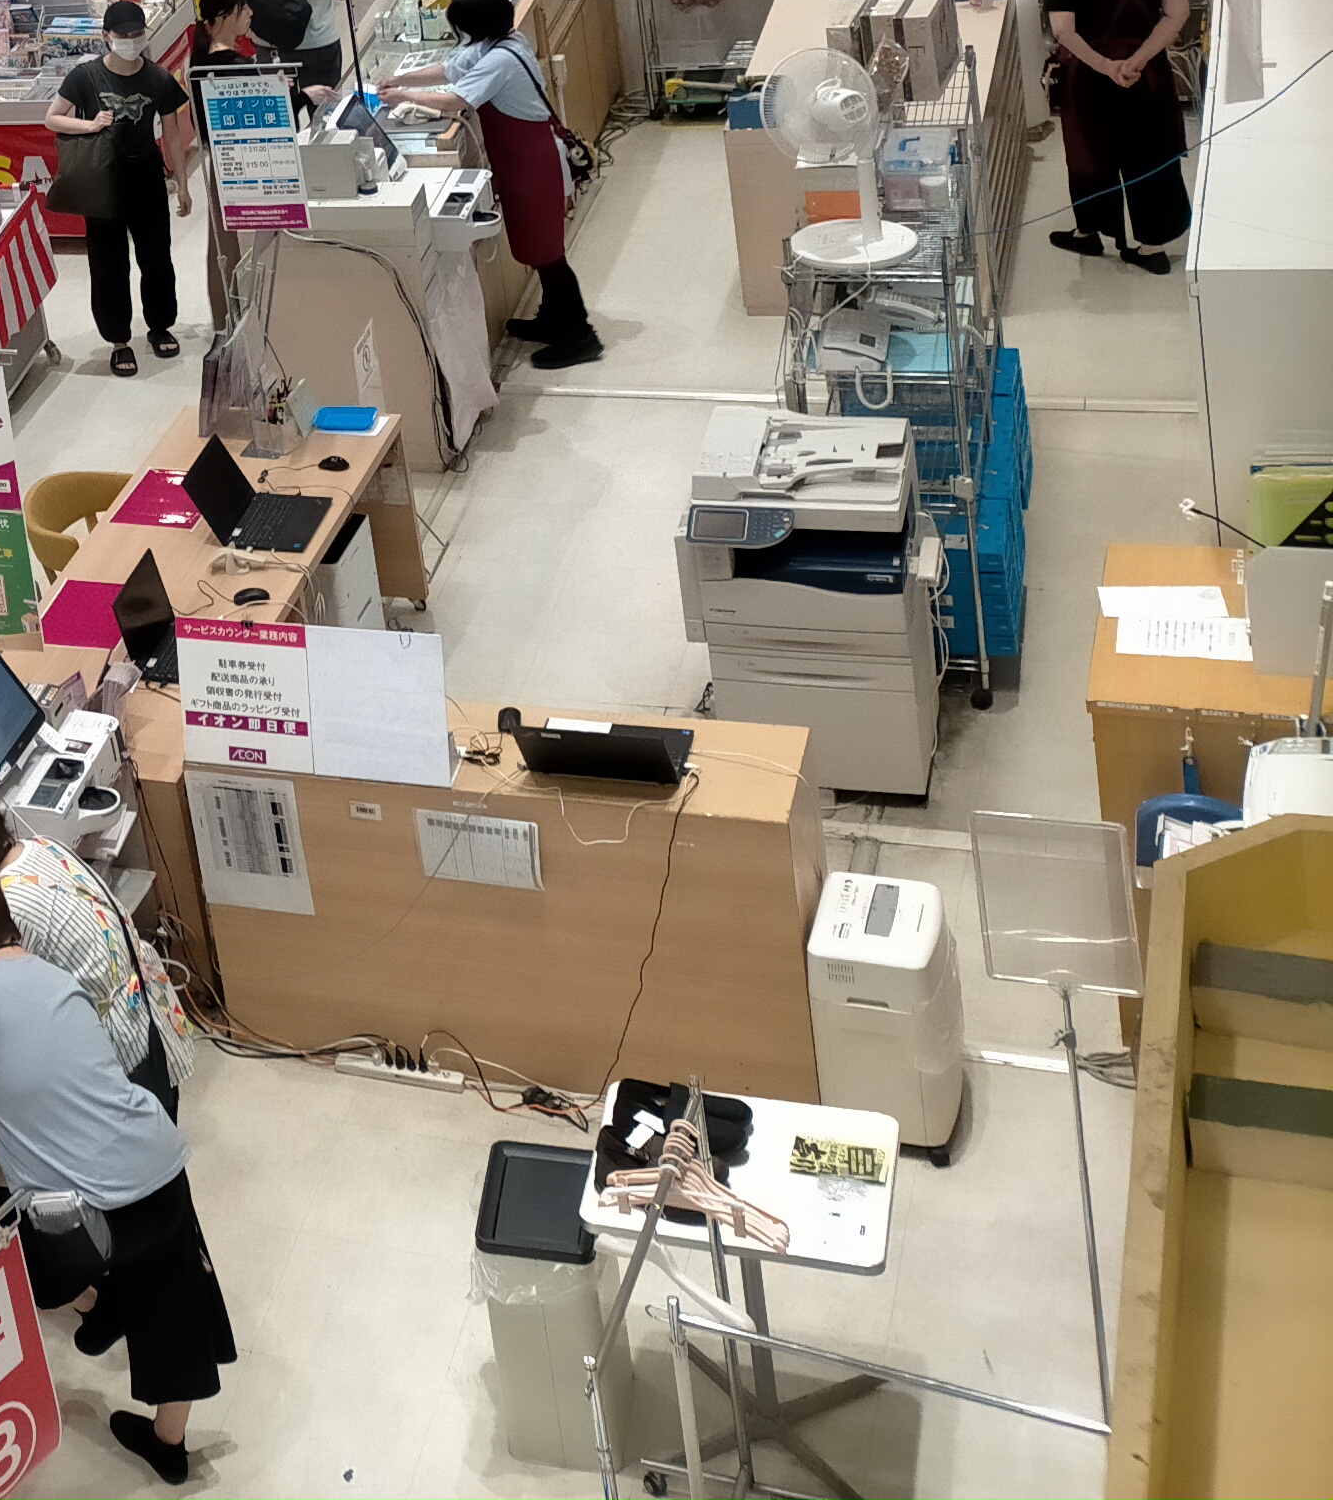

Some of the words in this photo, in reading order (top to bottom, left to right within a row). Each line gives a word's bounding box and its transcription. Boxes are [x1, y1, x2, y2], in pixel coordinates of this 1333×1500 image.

[221, 98, 275, 109] イオンの
[222, 112, 277, 127] 即日便
[183, 623, 298, 644] サービスカウンター業務内容
[218, 658, 267, 673] 駐車券受付
[210, 671, 276, 687] 配送商品の承り
[205, 685, 283, 703] 領収書の発行受付
[190, 698, 301, 719] ギフト商品のラッピング受付
[197, 713, 298, 735] イオン即日便
[231, 748, 265, 763] AEON
